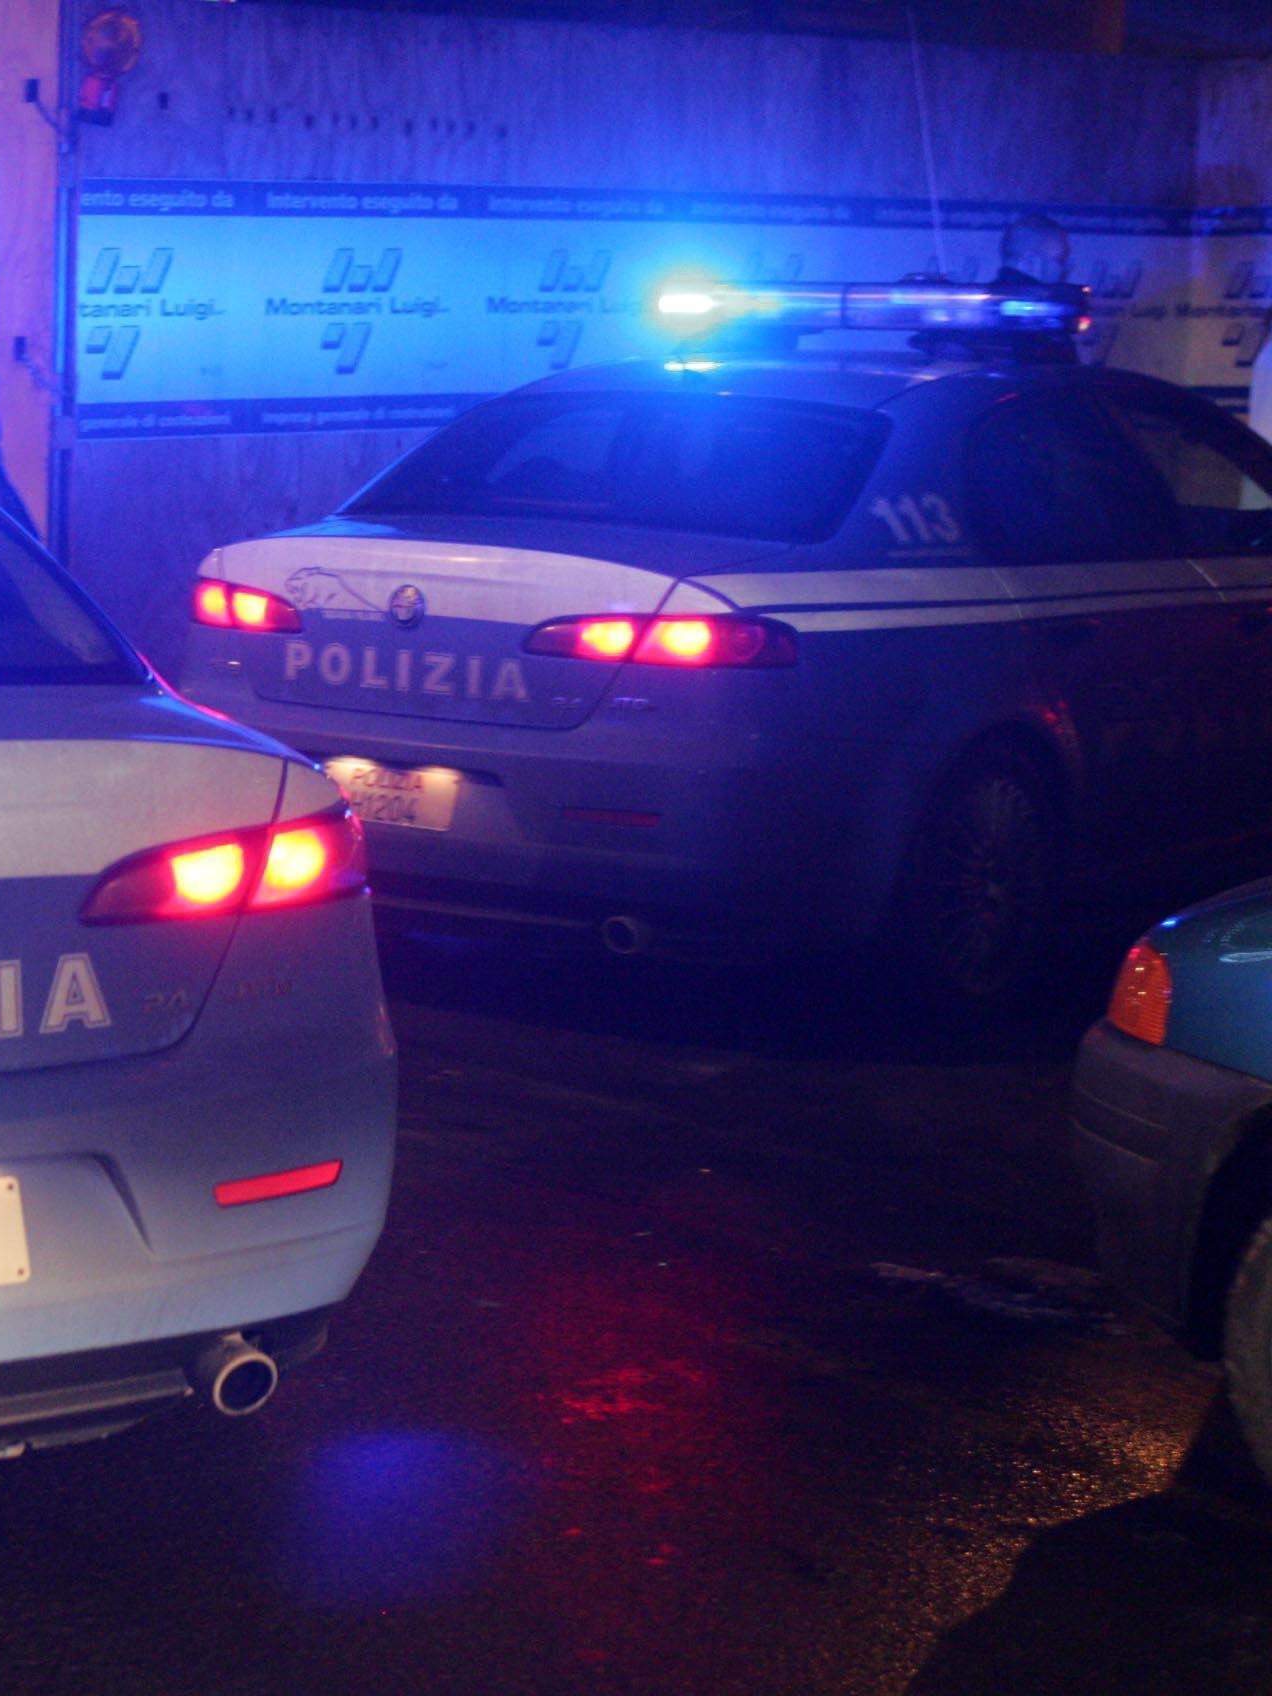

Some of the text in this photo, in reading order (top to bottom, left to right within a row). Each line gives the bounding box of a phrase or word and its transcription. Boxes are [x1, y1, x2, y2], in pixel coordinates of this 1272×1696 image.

[128, 188, 208, 213] eseguito
[211, 189, 234, 208] da
[265, 191, 459, 214] Intervento eseguito da
[160, 297, 216, 322] Luigi
[264, 296, 442, 320] Montanari Luigi
[485, 296, 595, 315] Montanari
[871, 493, 960, 544] 113
[283, 639, 532, 703] POLIZIA
